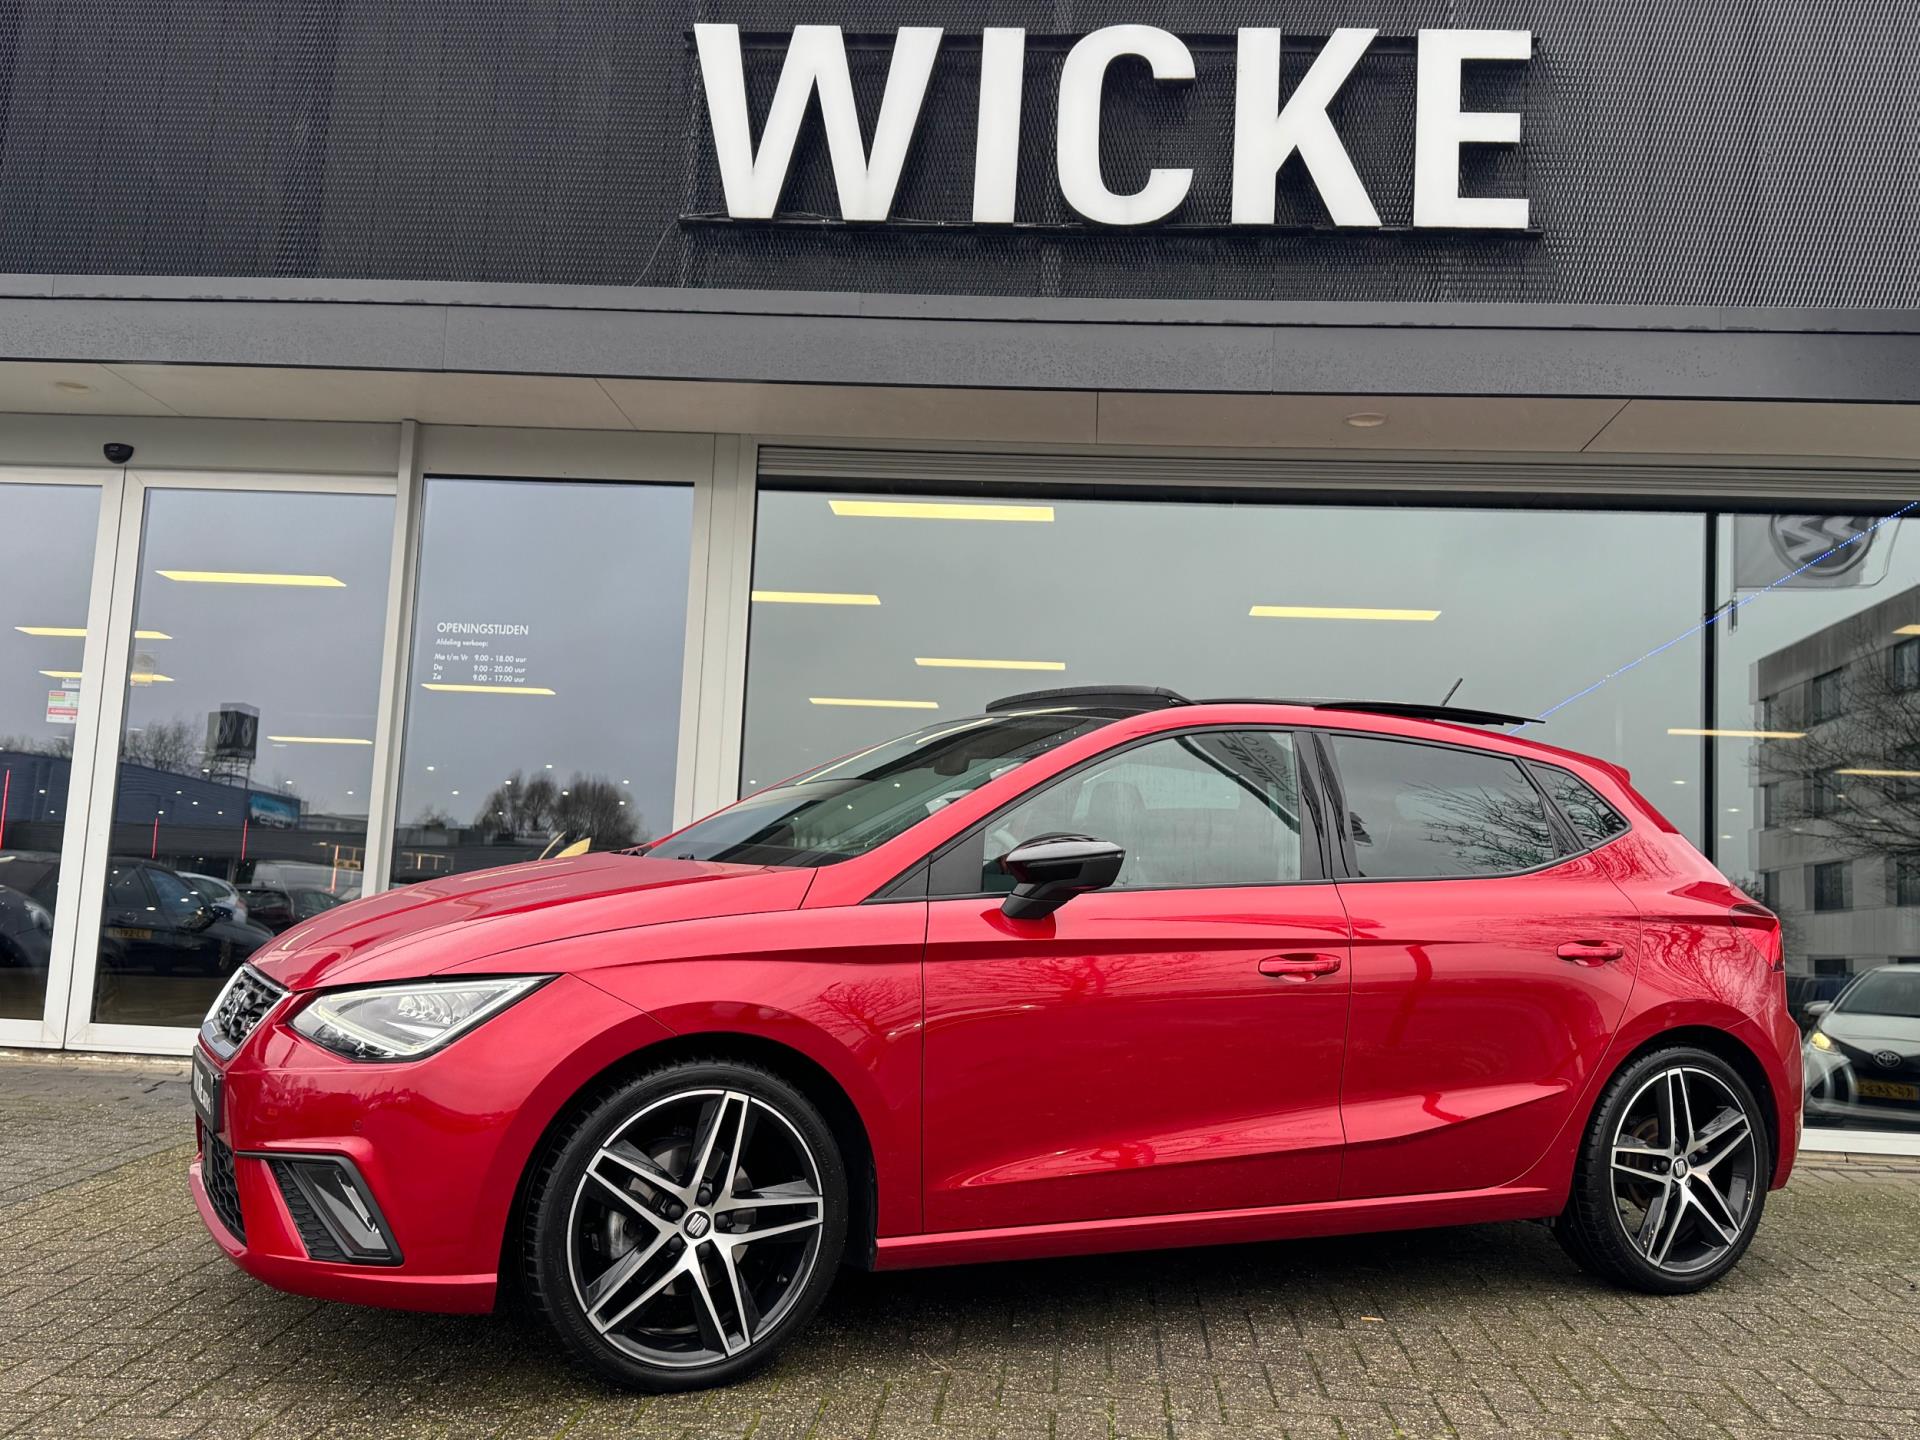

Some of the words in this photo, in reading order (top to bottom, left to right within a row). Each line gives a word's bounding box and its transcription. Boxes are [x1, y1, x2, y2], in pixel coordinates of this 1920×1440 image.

[693, 23, 1533, 230] WICKE
[436, 638, 461, 647] Afdeling
[446, 653, 459, 661] t/m
[474, 654, 489, 662] 9.00
[495, 655, 514, 663] 18.00
[494, 665, 513, 673] 20.00
[495, 675, 513, 683] 17.00
